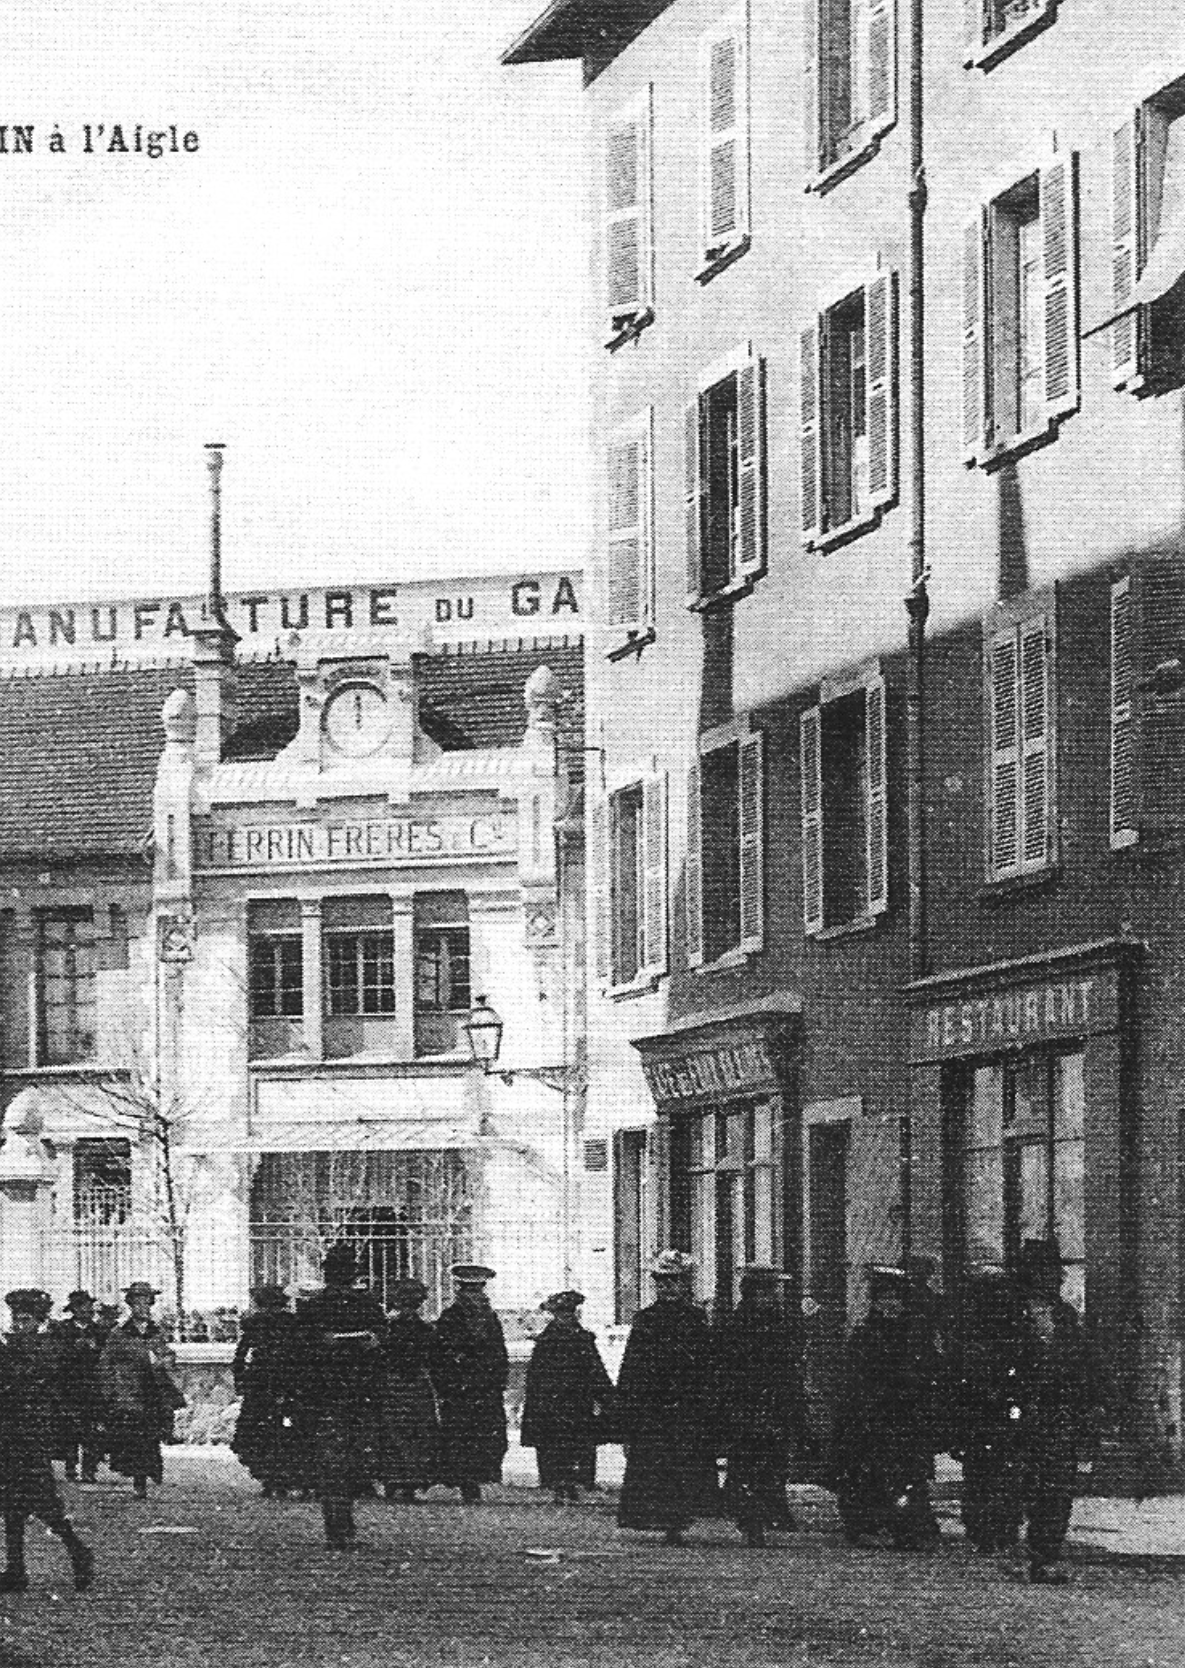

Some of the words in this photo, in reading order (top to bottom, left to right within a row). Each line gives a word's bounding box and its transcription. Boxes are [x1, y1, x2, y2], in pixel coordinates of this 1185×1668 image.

[434, 597, 474, 623] DU
[207, 828, 314, 862] PERRIN
[925, 980, 1094, 1049] RESTAURANT
